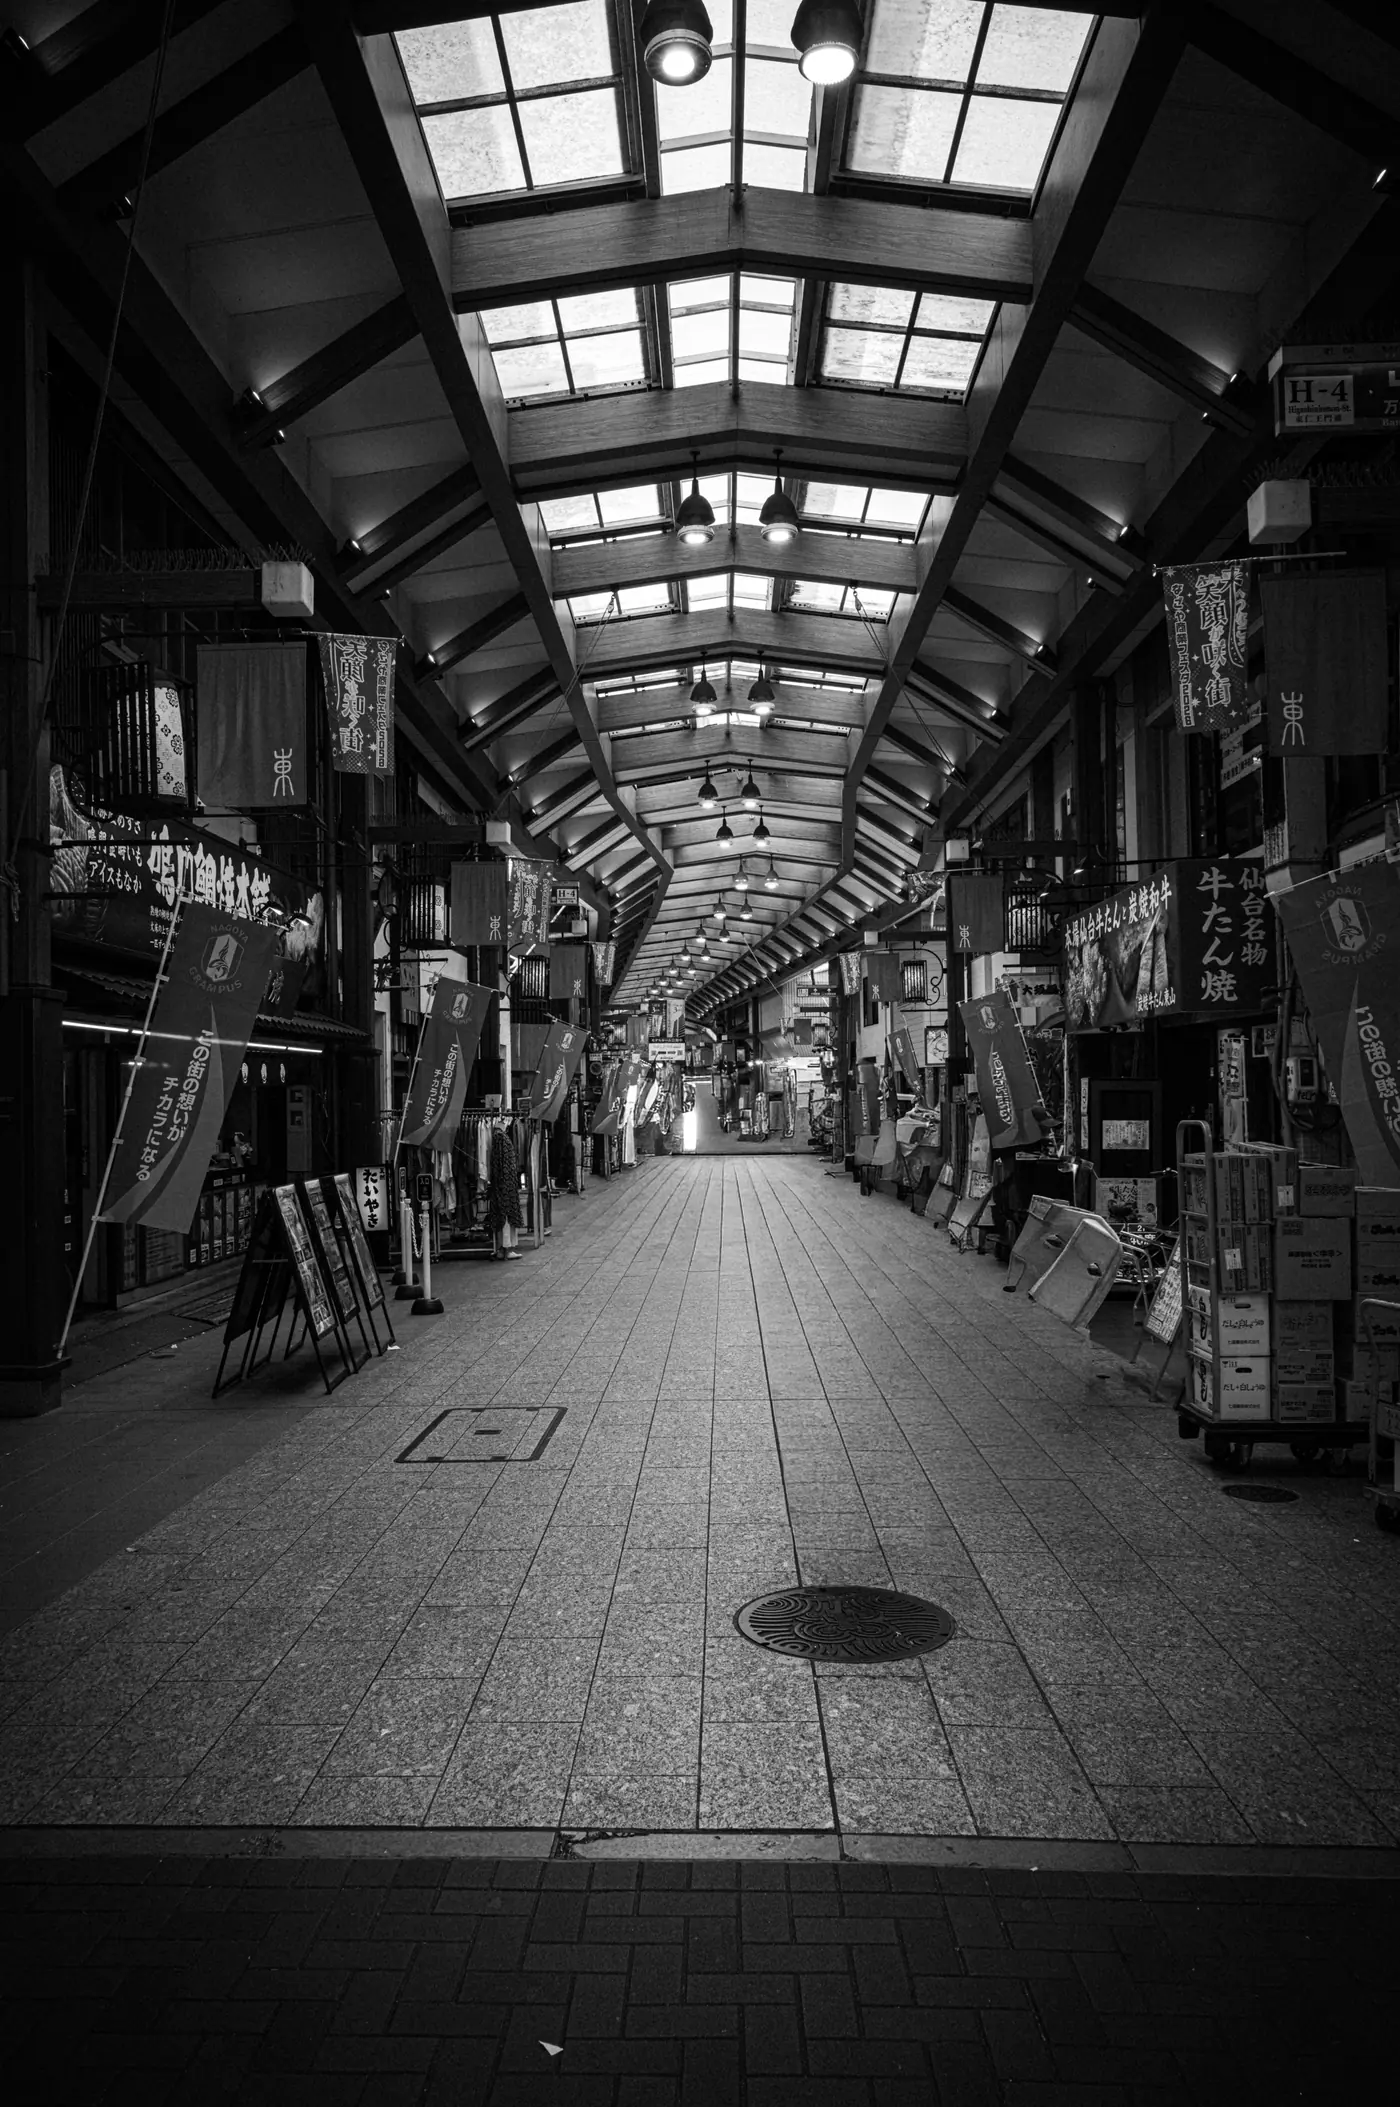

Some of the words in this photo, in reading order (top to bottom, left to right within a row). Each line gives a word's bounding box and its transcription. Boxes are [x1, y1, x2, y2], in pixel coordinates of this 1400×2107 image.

[1289, 380, 1348, 403] H-4
[1195, 573, 1231, 708] 笑顔が咲く街
[1279, 691, 1307, 747] 東
[273, 747, 295, 798] 東
[88, 859, 143, 894] アイスもなか
[558, 890, 575, 898] H-4
[210, 924, 249, 944] NAGOYA
[489, 915, 502, 941] 東
[958, 924, 971, 949] 東
[1195, 866, 1239, 1002] 牛たん焼
[1238, 867, 1269, 967] 仙台名物
[189, 966, 242, 994] GRAMPUS
[167, 1029, 214, 1143] この街の想いが
[136, 1076, 179, 1182] チカラになる
[362, 1168, 379, 1228] たいやき
[420, 1177, 430, 1185] 入口
